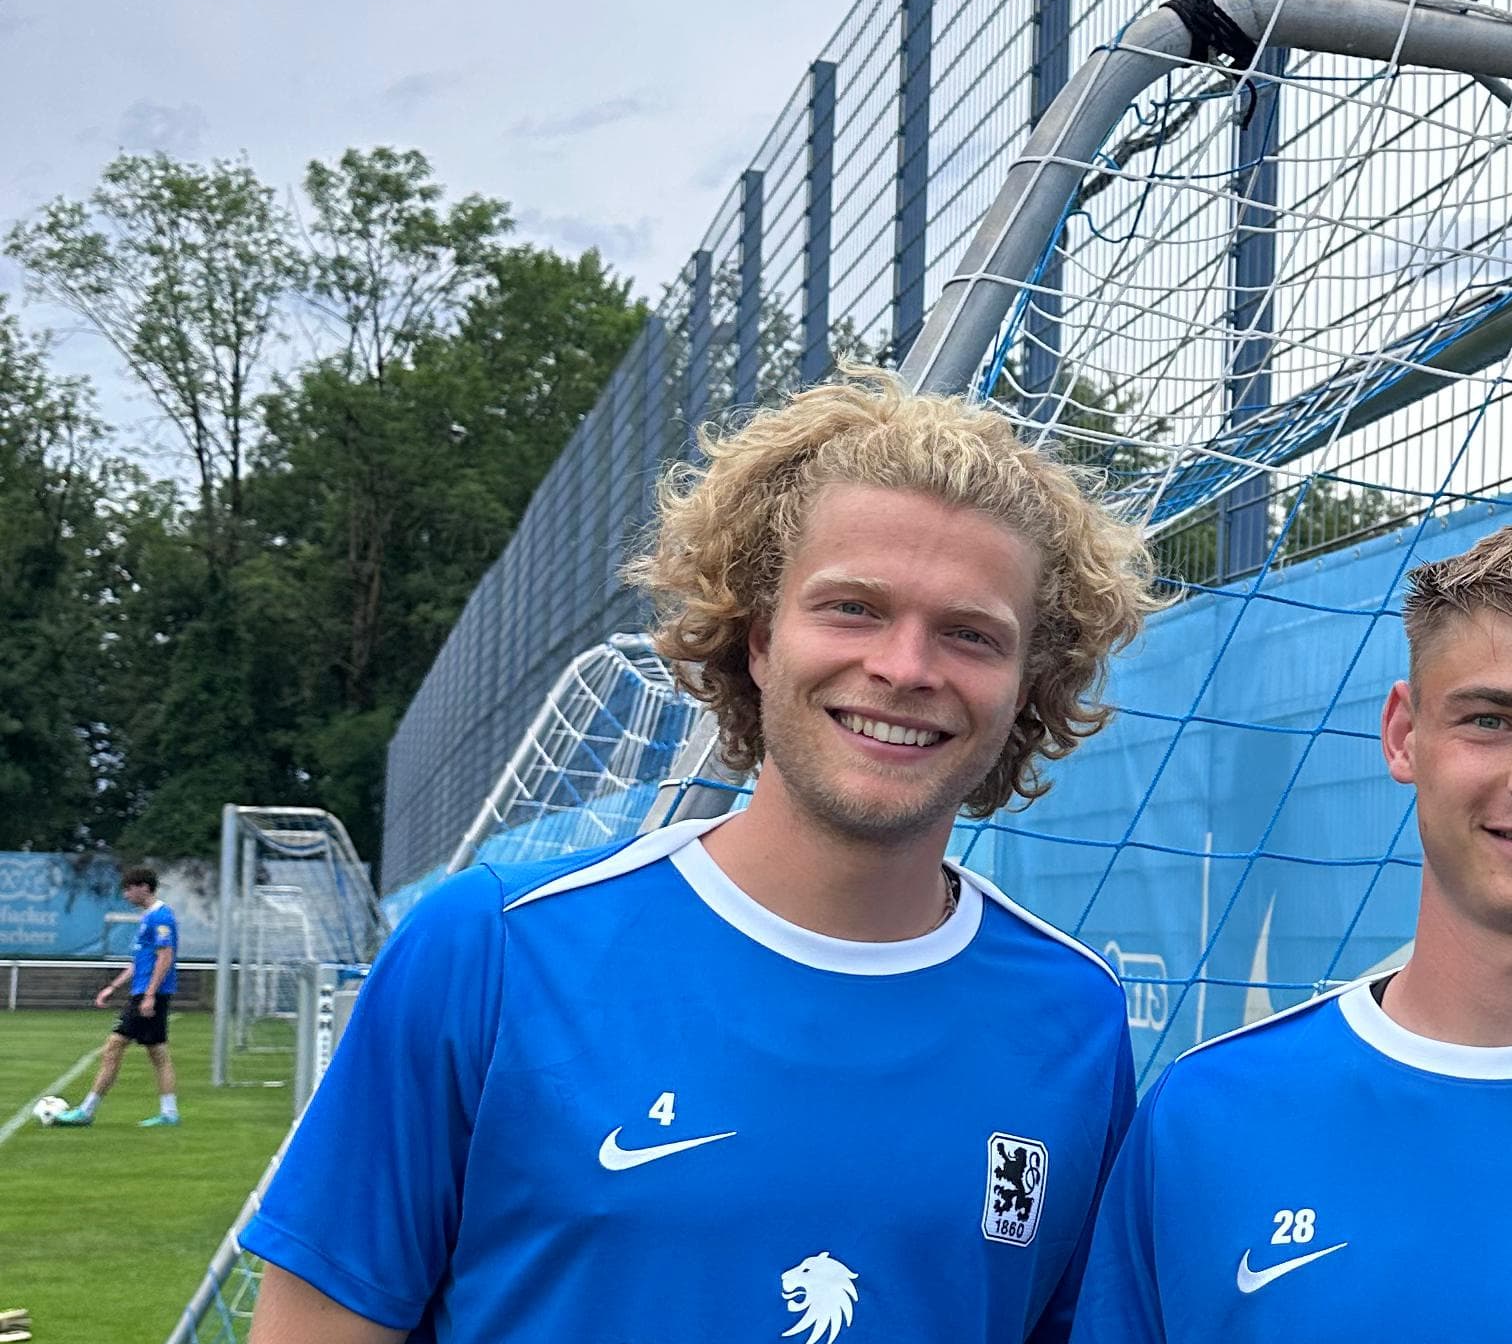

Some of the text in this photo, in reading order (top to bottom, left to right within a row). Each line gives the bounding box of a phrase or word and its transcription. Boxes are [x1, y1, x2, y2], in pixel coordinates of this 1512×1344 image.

[647, 1091, 677, 1127] 4
[994, 1218, 1025, 1240] 1860
[1270, 1207, 1317, 1246] 28
